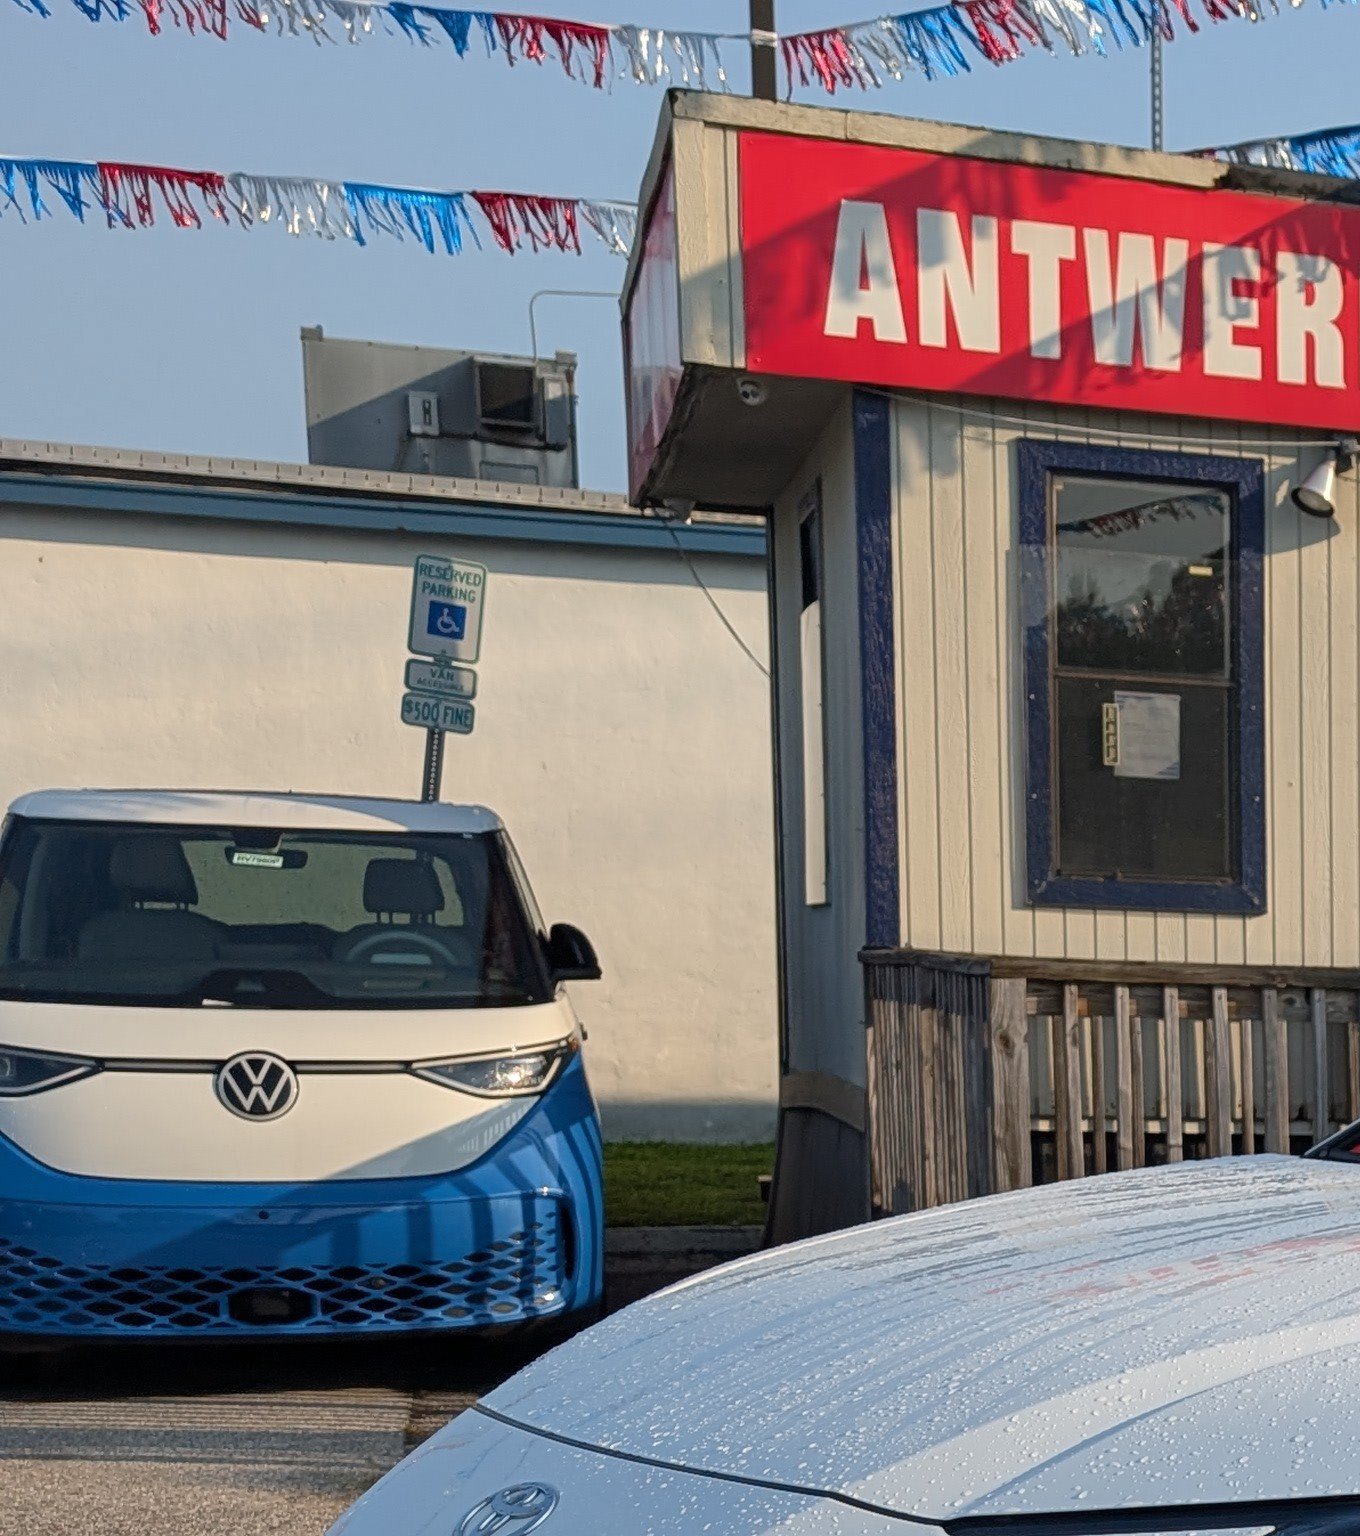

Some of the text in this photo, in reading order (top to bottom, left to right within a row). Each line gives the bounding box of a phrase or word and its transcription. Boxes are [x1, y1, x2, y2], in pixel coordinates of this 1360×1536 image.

[419, 562, 482, 587] RESERVED
[421, 580, 476, 604] PARKING
[404, 698, 440, 723] $500
[443, 705, 472, 728] FINE
